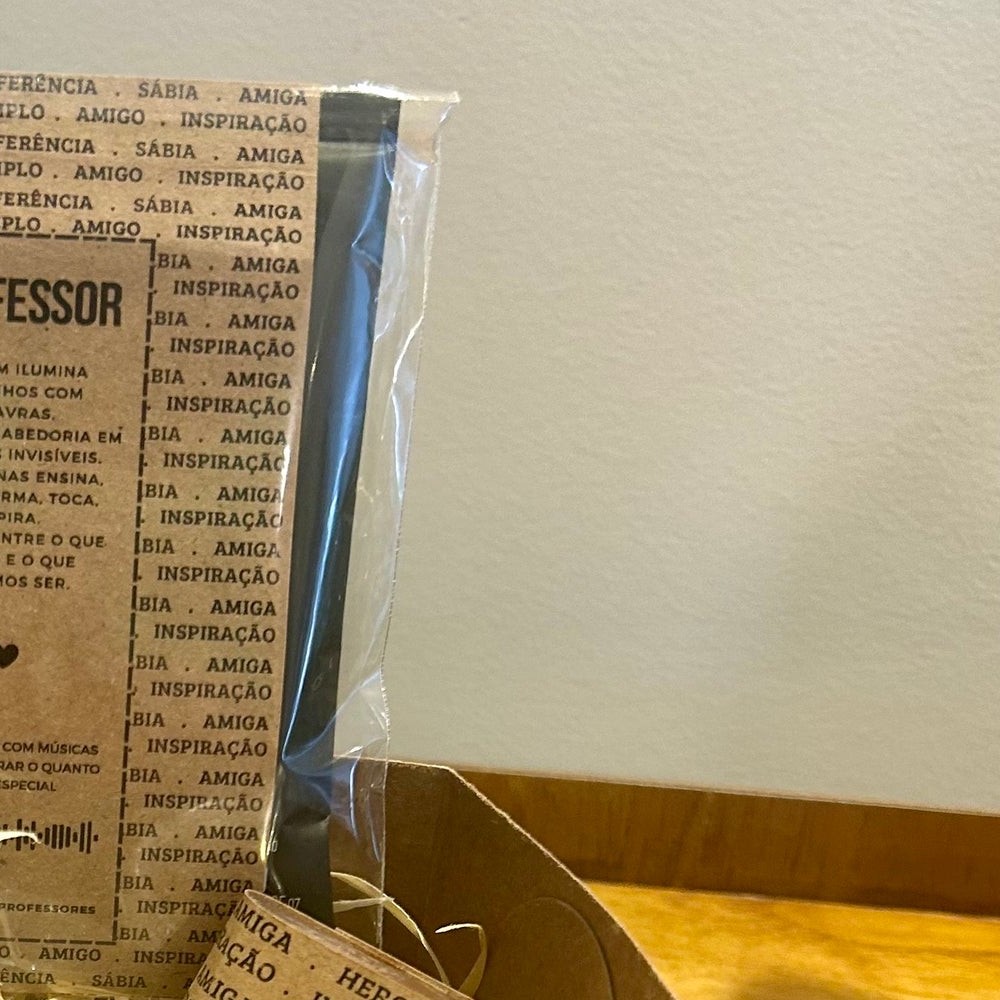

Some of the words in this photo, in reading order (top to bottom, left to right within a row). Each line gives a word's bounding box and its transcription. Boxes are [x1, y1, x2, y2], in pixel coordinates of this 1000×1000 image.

[139, 79, 199, 101] SÁBIA
[239, 87, 308, 106] AMIGA
[76, 106, 145, 126] AMIGO
[181, 111, 307, 136] INSPIRAÇÃO
[136, 139, 196, 160] SÁBIA
[236, 147, 305, 165] AMIGA
[74, 164, 143, 183] AMIGO
[179, 170, 305, 194] INSPIRAÇÃO
[134, 194, 194, 215] SÁBIA
[234, 203, 303, 221] AMIGA
[72, 219, 141, 237] AMIGO
[177, 225, 302, 247] INSPIRAÇÃO
[231, 256, 300, 274] AMIGA
[174, 280, 299, 303] INSPIRAÇÃO
[228, 314, 296, 332] AMIGA
[170, 338, 295, 361] INSPIRAÇÃO
[16, 363, 89, 379] ILUMINA
[224, 371, 292, 389] AMIGA
[44, 386, 83, 400] COM
[166, 396, 291, 419] INSPIRAÇÃO
[98, 431, 122, 444] EM
[221, 428, 287, 446] AMIGA
[217, 486, 282, 504] AMIGA
[161, 509, 283, 532] INSPIRAÇÃO
[51, 534, 64, 547] O
[69, 535, 105, 549] QUE
[214, 541, 280, 559] AMIGA
[6, 553, 16, 566] E
[22, 554, 34, 567] O
[40, 556, 76, 570] QUE
[157, 566, 280, 589] INSPIRAÇÃO
[210, 599, 277, 617] AMIGA
[154, 624, 276, 647] INSPIRAÇÃO
[206, 657, 273, 675] AMIGA
[150, 681, 272, 704] INSPIRAÇÃO
[202, 714, 269, 731] AMIGA
[2, 742, 34, 754] COM
[38, 741, 99, 755] MÚSICAS
[147, 738, 268, 761] INSPIRAÇÃO
[28, 762, 39, 772] O
[41, 762, 100, 775] QUANTO
[199, 771, 265, 787] AMIGA
[144, 793, 263, 816] INSPIRAÇÃO
[195, 825, 259, 841] AMIGA
[141, 847, 259, 869] INSPIRAÇÃO
[191, 878, 254, 894] AMIGA
[39, 947, 102, 962] AMIGO
[92, 971, 147, 988] SÁBIA
